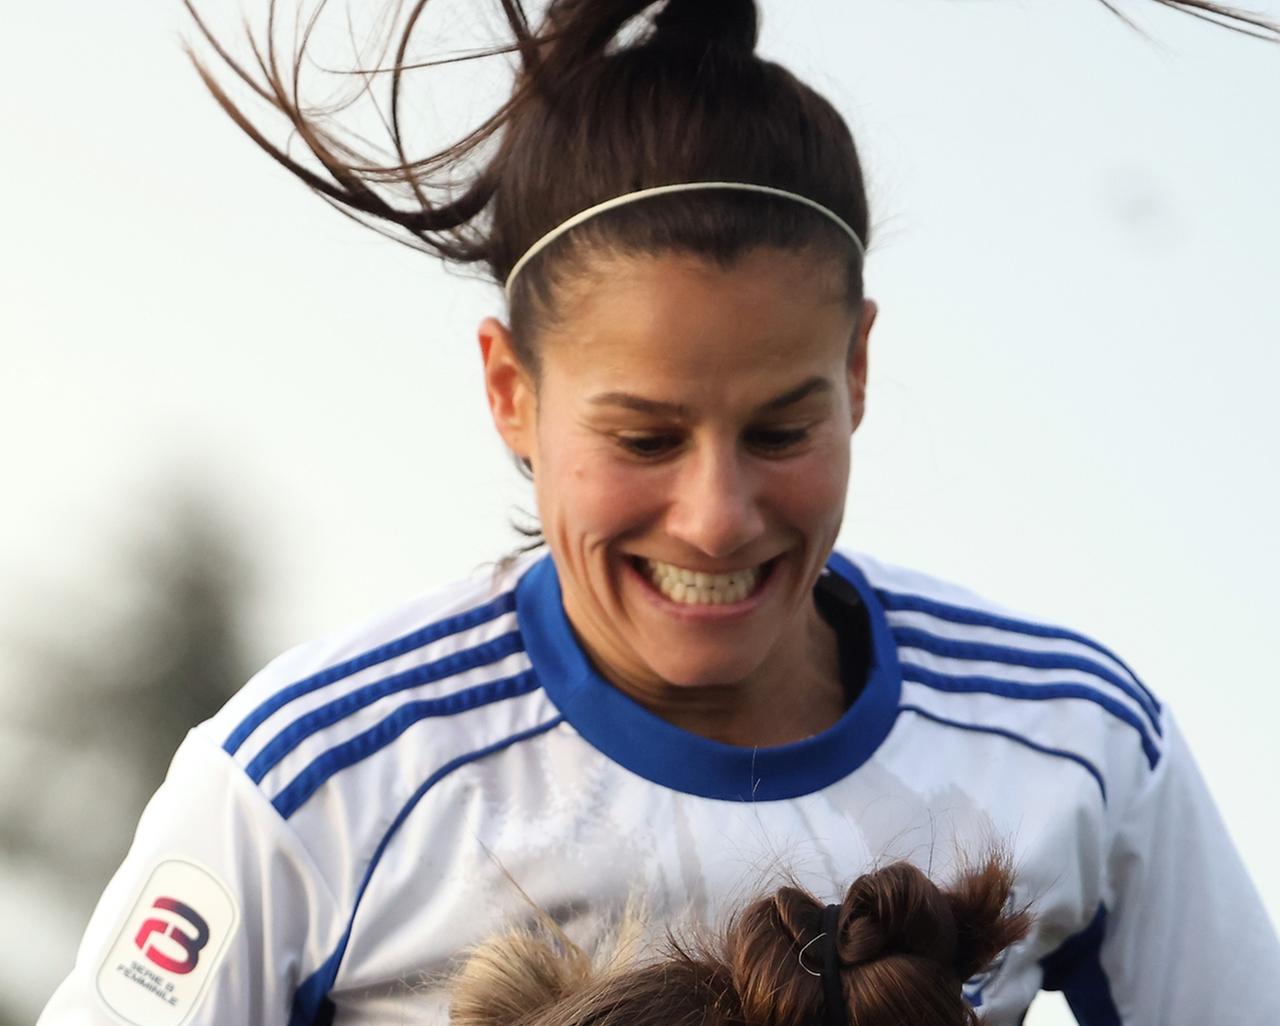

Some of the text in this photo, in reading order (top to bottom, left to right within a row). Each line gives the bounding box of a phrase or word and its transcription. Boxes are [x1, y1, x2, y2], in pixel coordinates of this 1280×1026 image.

[117, 963, 179, 1006] FEMMINILE
[130, 960, 176, 993] SERIE B
